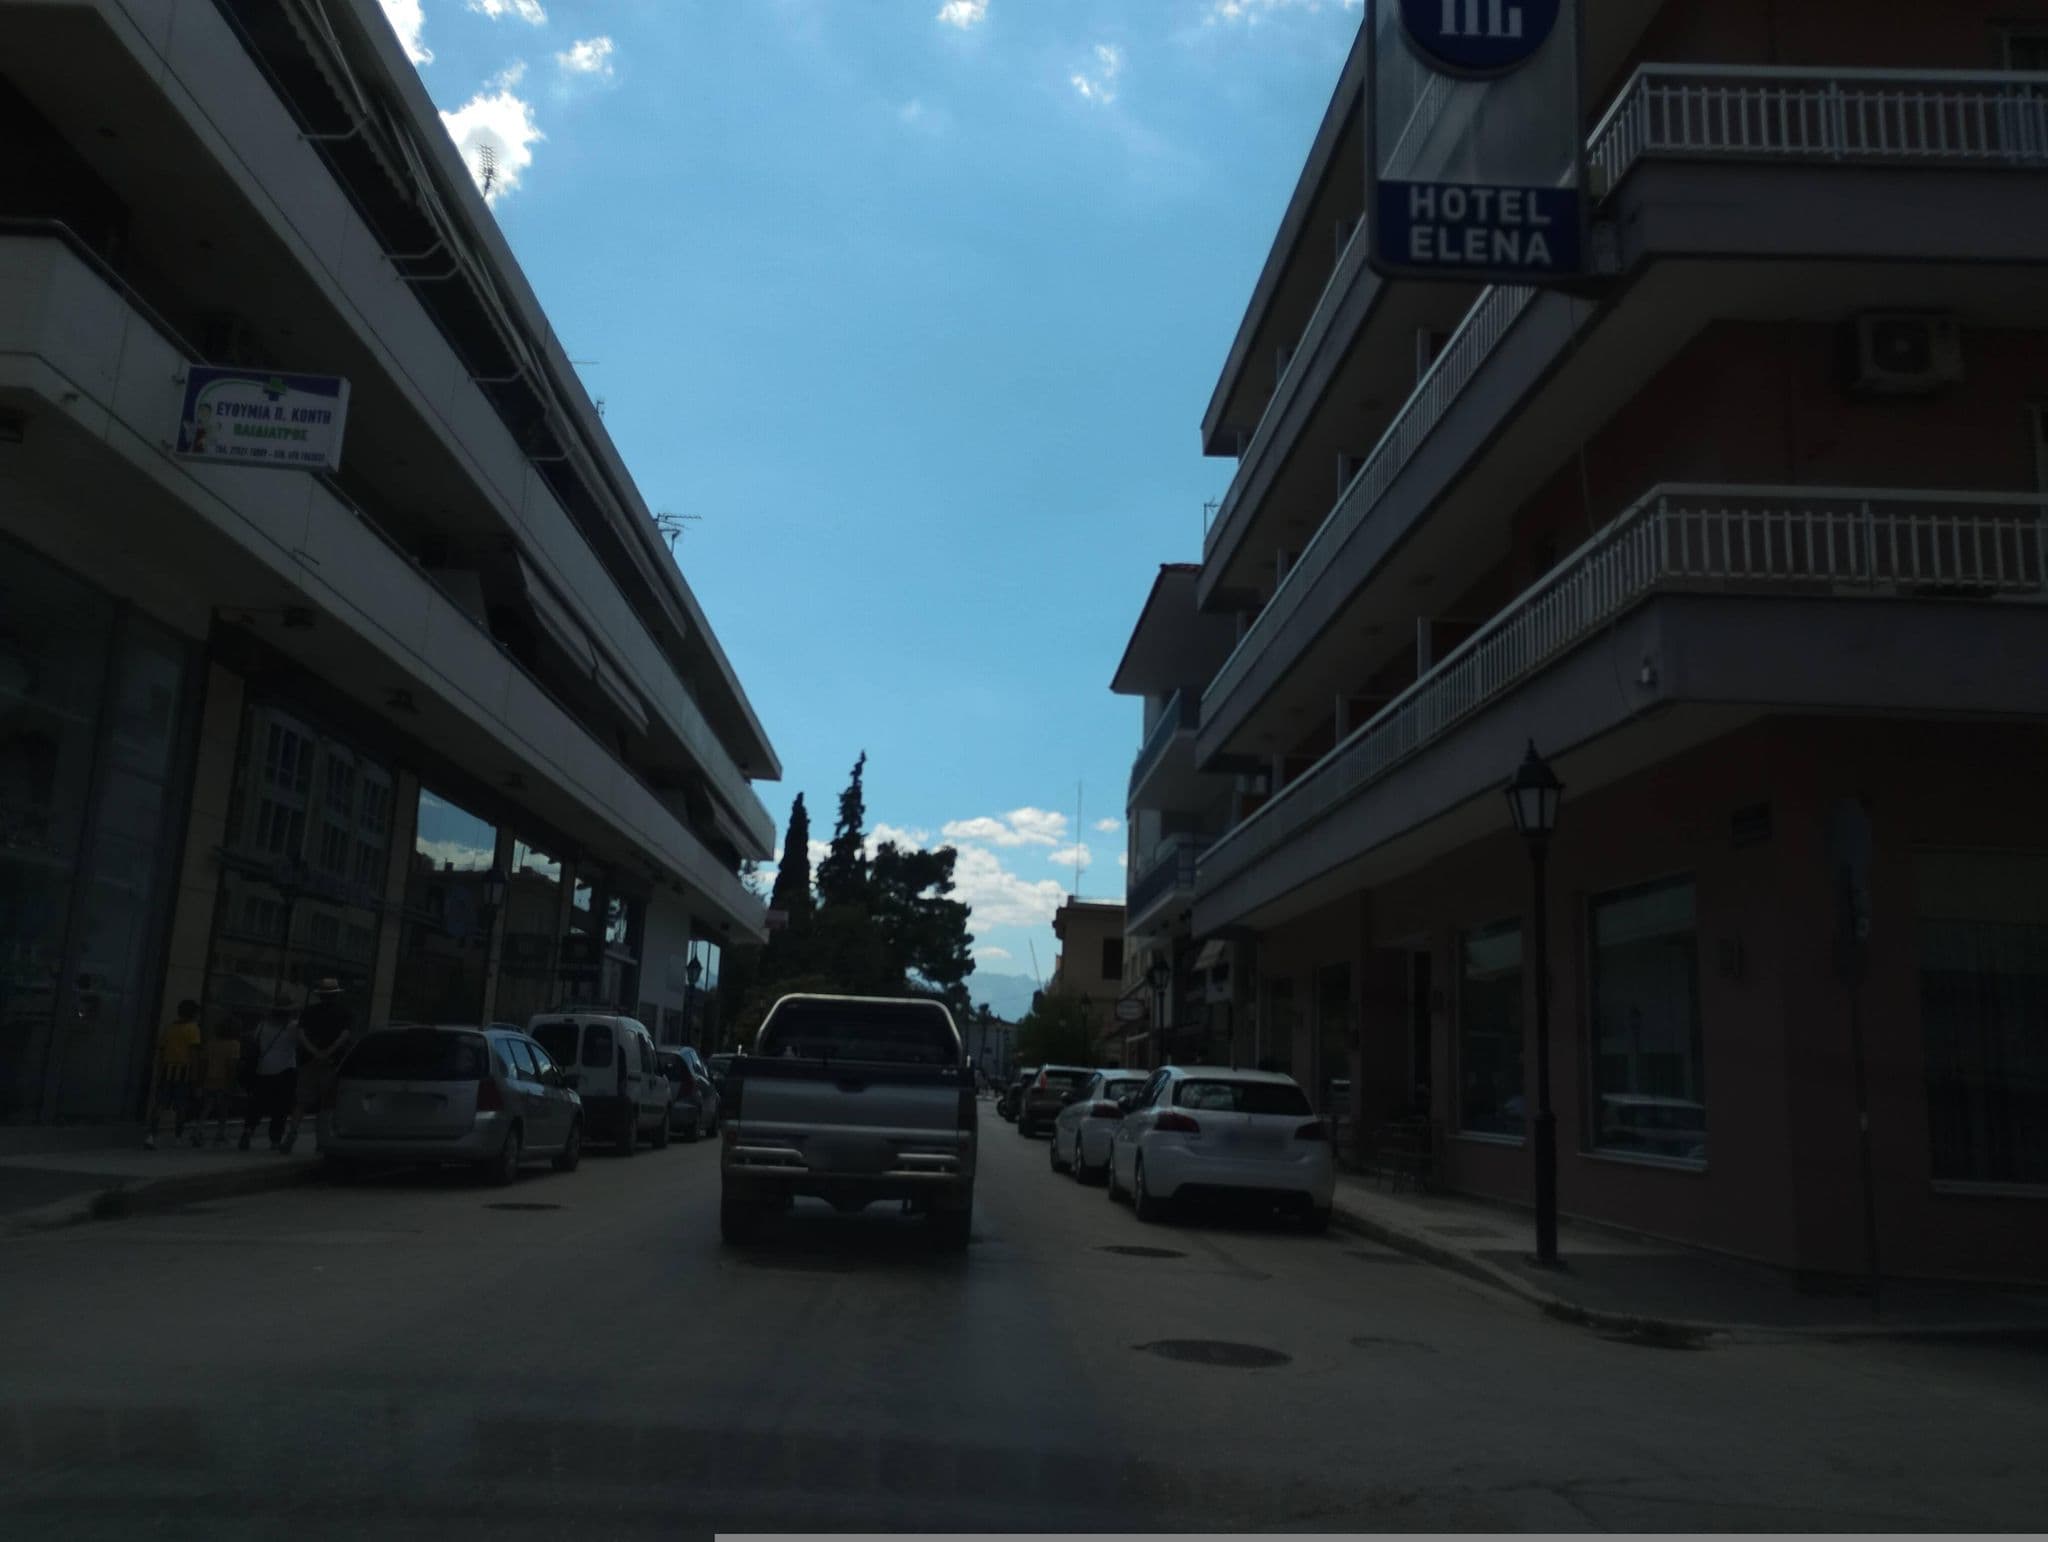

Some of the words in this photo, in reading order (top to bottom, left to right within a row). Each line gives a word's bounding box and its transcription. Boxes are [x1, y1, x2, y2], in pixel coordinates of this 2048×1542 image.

[1409, 184, 1552, 225] HOTEL
[1409, 225, 1552, 265] ELENA
[291, 407, 332, 424] ΚΟΝΤΗ
[233, 423, 308, 440] ΠΑΙΔΙΑΤΡΟΣ
